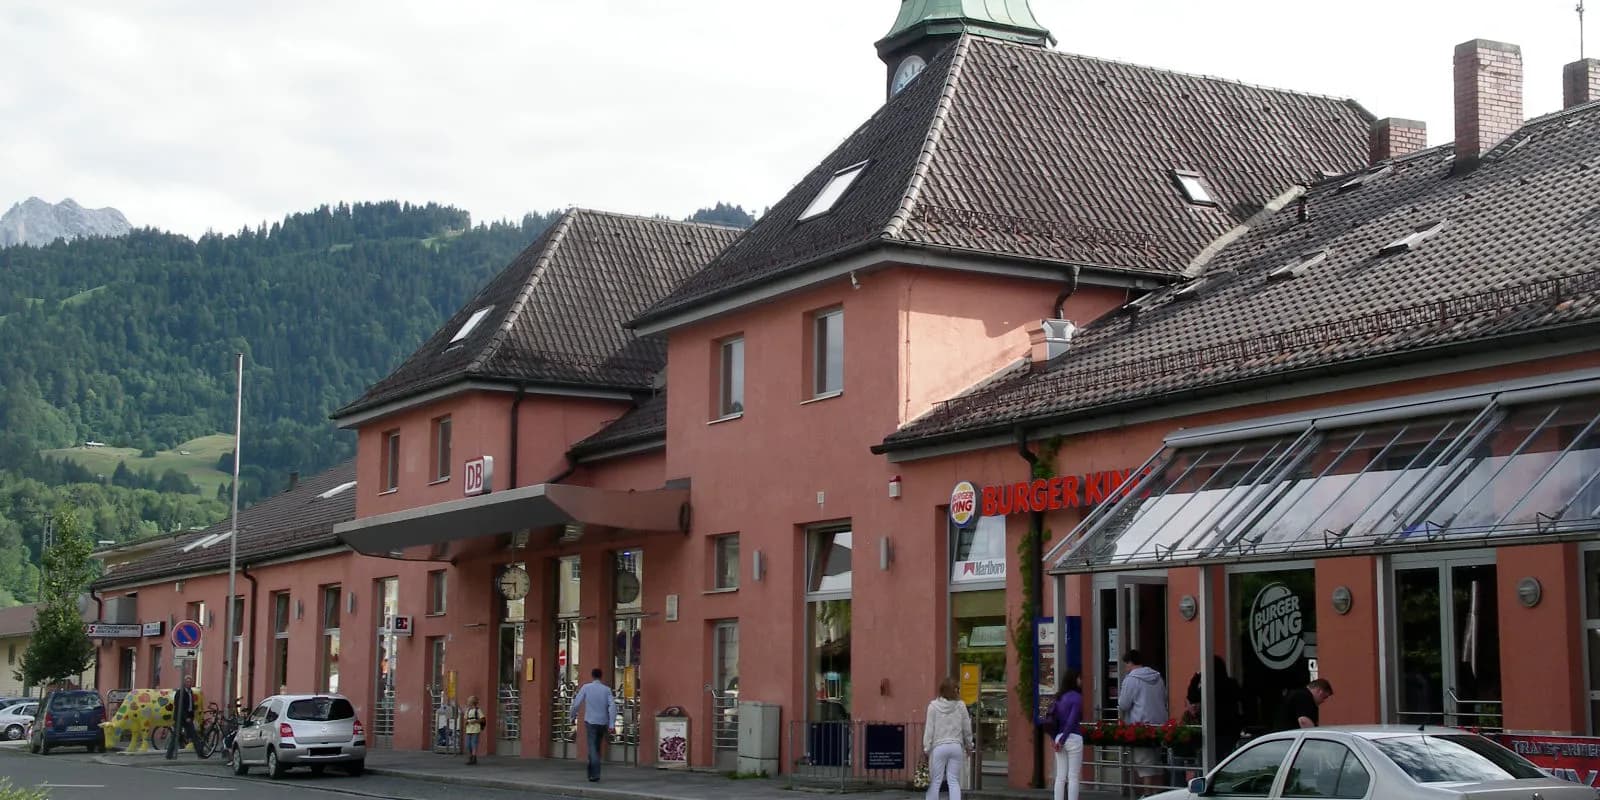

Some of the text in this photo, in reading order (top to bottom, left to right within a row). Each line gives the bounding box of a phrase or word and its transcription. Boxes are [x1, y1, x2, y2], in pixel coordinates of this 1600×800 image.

[467, 463, 482, 491] DB
[951, 500, 973, 514] KING
[981, 475, 1080, 517] BURGER
[975, 560, 1005, 576] Marlboro
[1255, 595, 1300, 631] BURGER
[1256, 610, 1302, 653] KING
